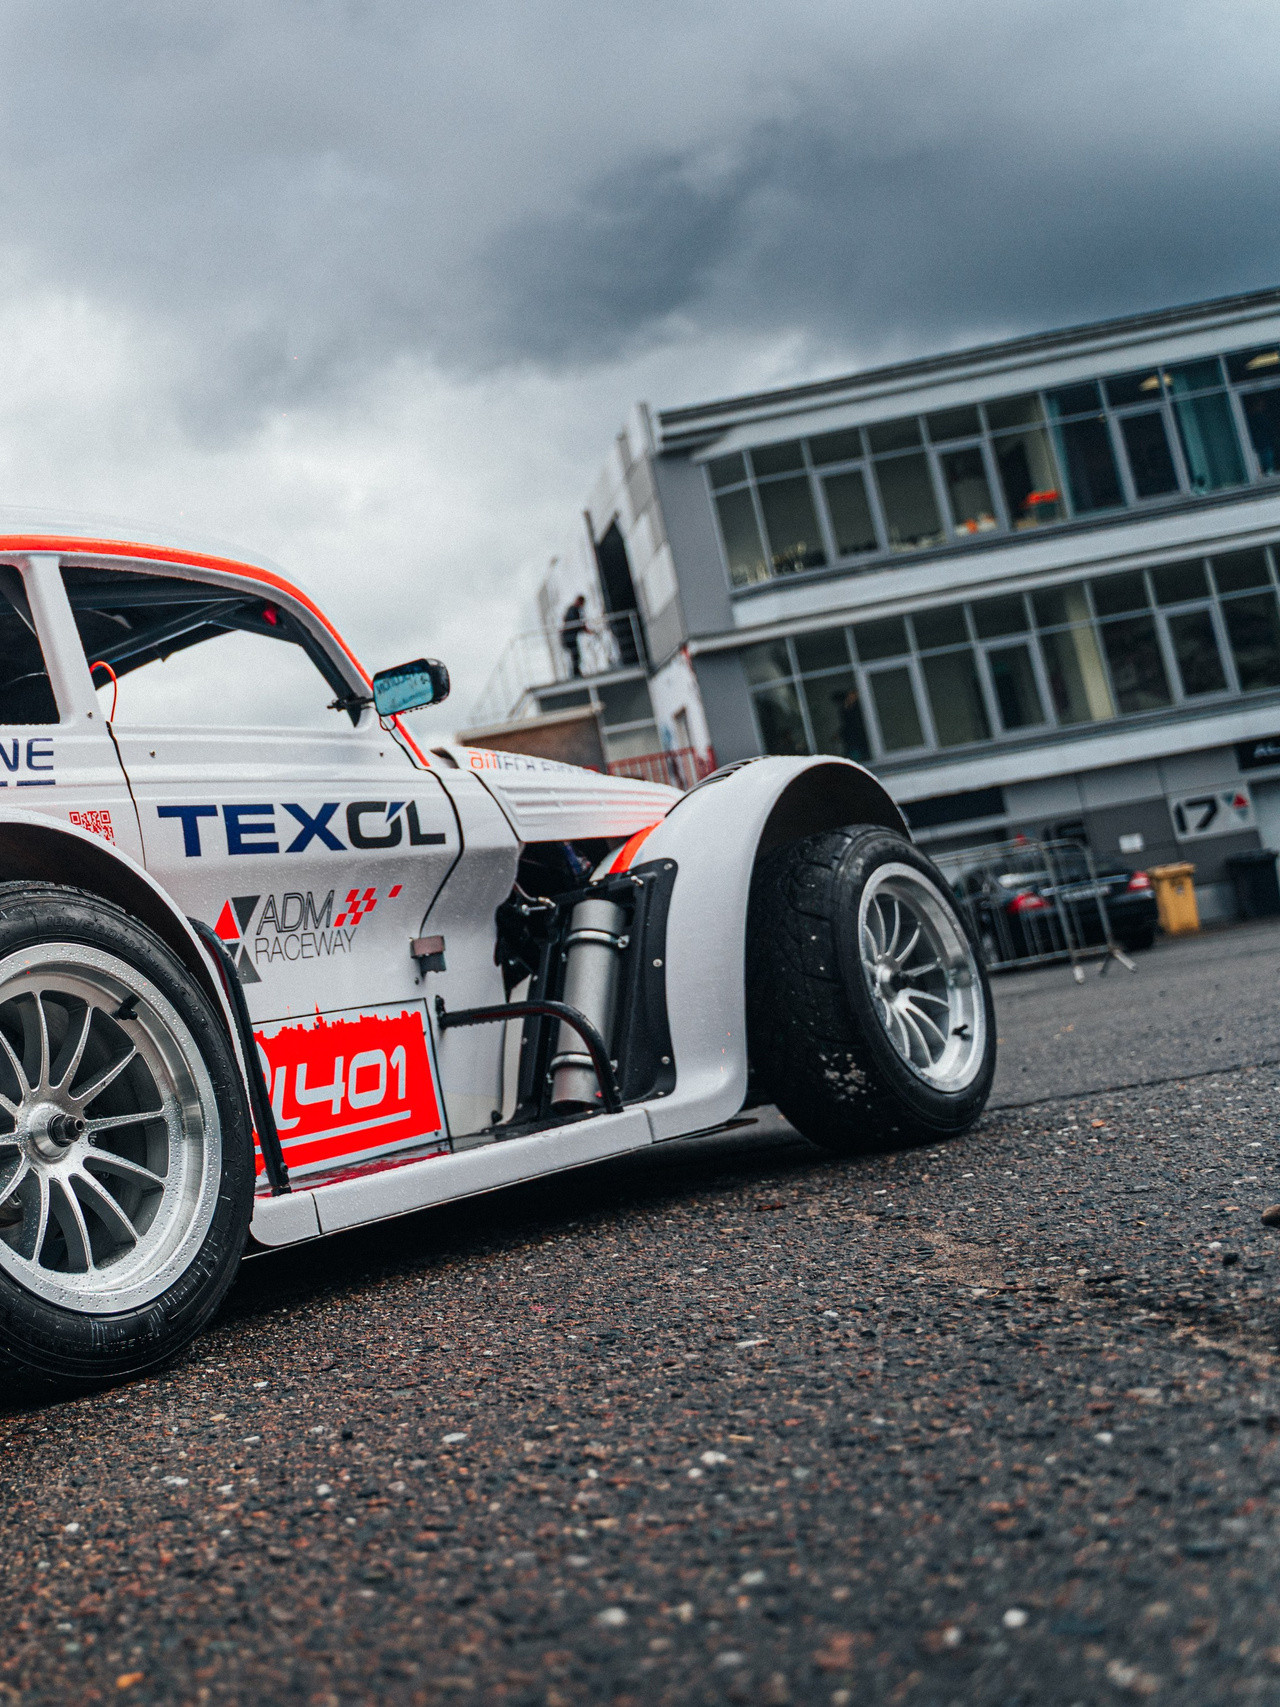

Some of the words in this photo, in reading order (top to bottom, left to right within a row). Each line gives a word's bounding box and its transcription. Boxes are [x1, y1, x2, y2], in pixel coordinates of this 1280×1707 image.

[157, 800, 446, 857] TEXOL
[256, 889, 335, 936] ADM
[254, 927, 357, 965] RACEWAY
